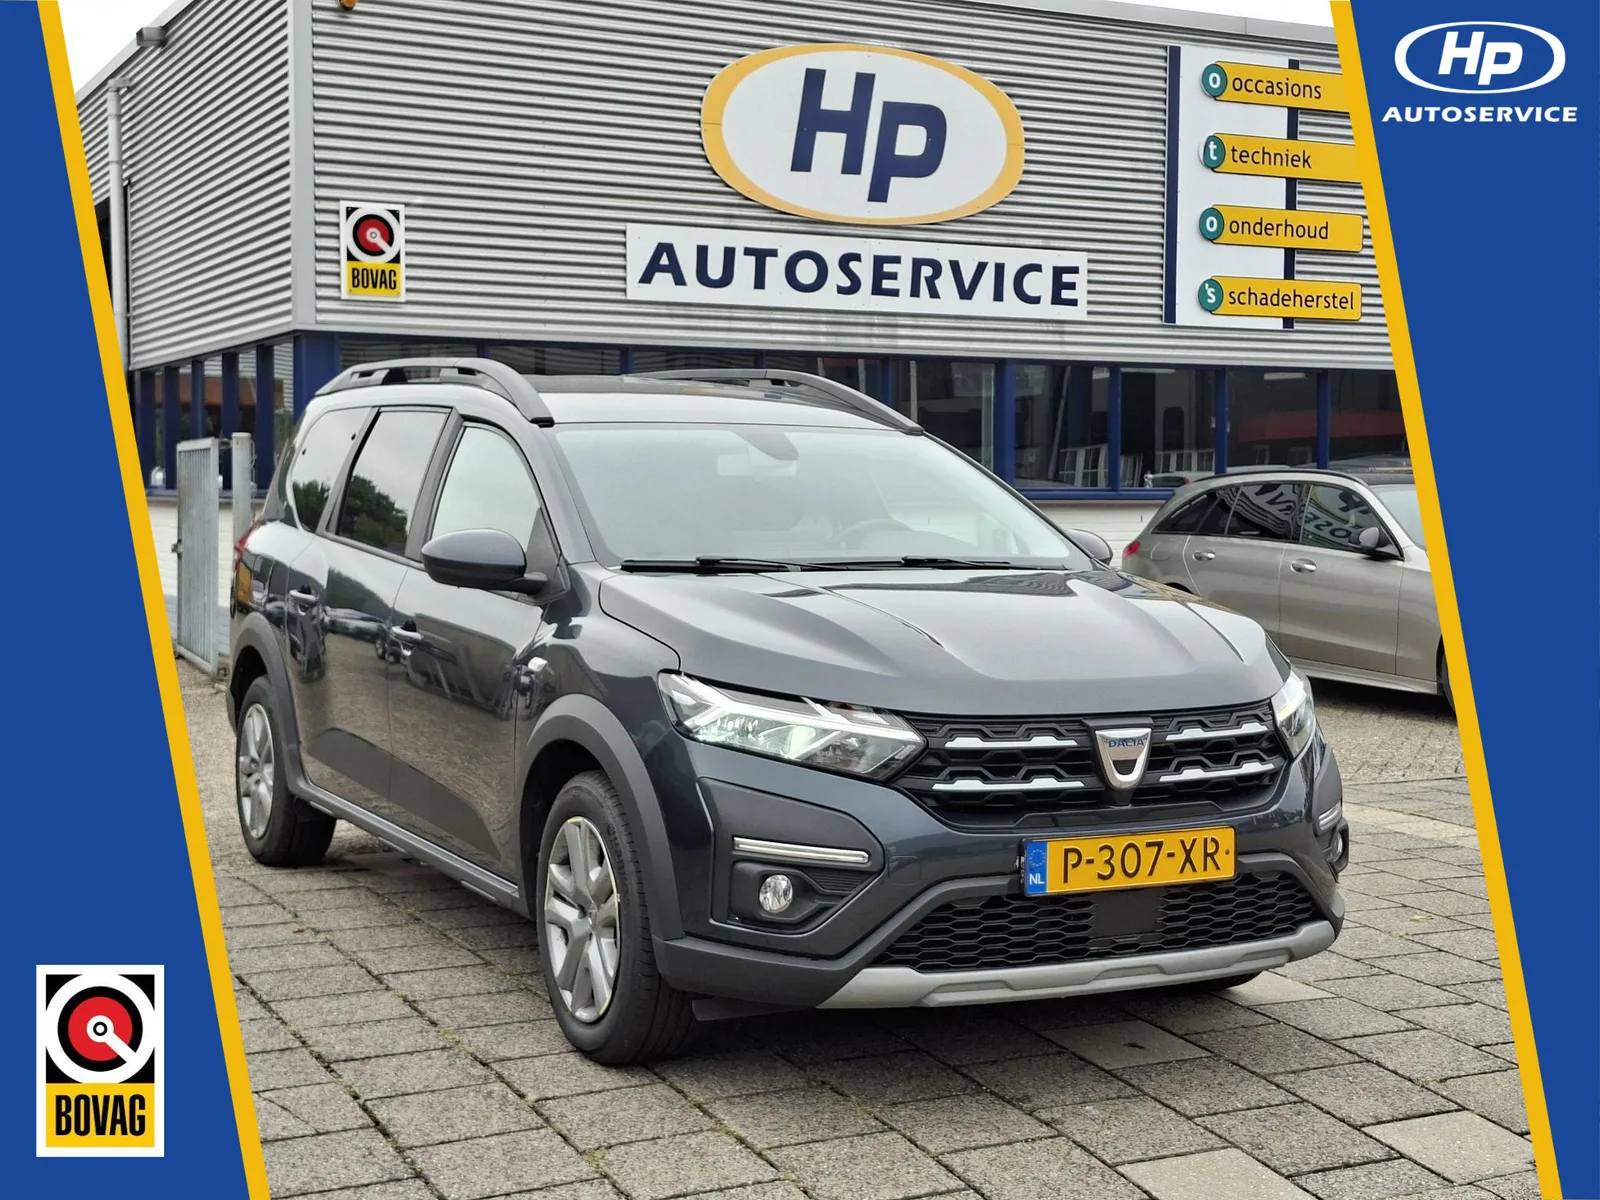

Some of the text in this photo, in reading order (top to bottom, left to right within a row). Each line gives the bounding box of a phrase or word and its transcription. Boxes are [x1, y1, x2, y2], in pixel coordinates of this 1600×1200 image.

[1232, 71, 1322, 100] occasions
[790, 67, 947, 203] Hp
[1230, 145, 1312, 169] techniek
[1229, 217, 1329, 240] onderhoud
[351, 267, 397, 290] BOVAG
[638, 242, 1080, 307] AUTOSERVICE
[1228, 286, 1354, 310] schadeherstel
[1108, 738, 1144, 748] DACIA
[1029, 837, 1221, 885] NL P-307-XR
